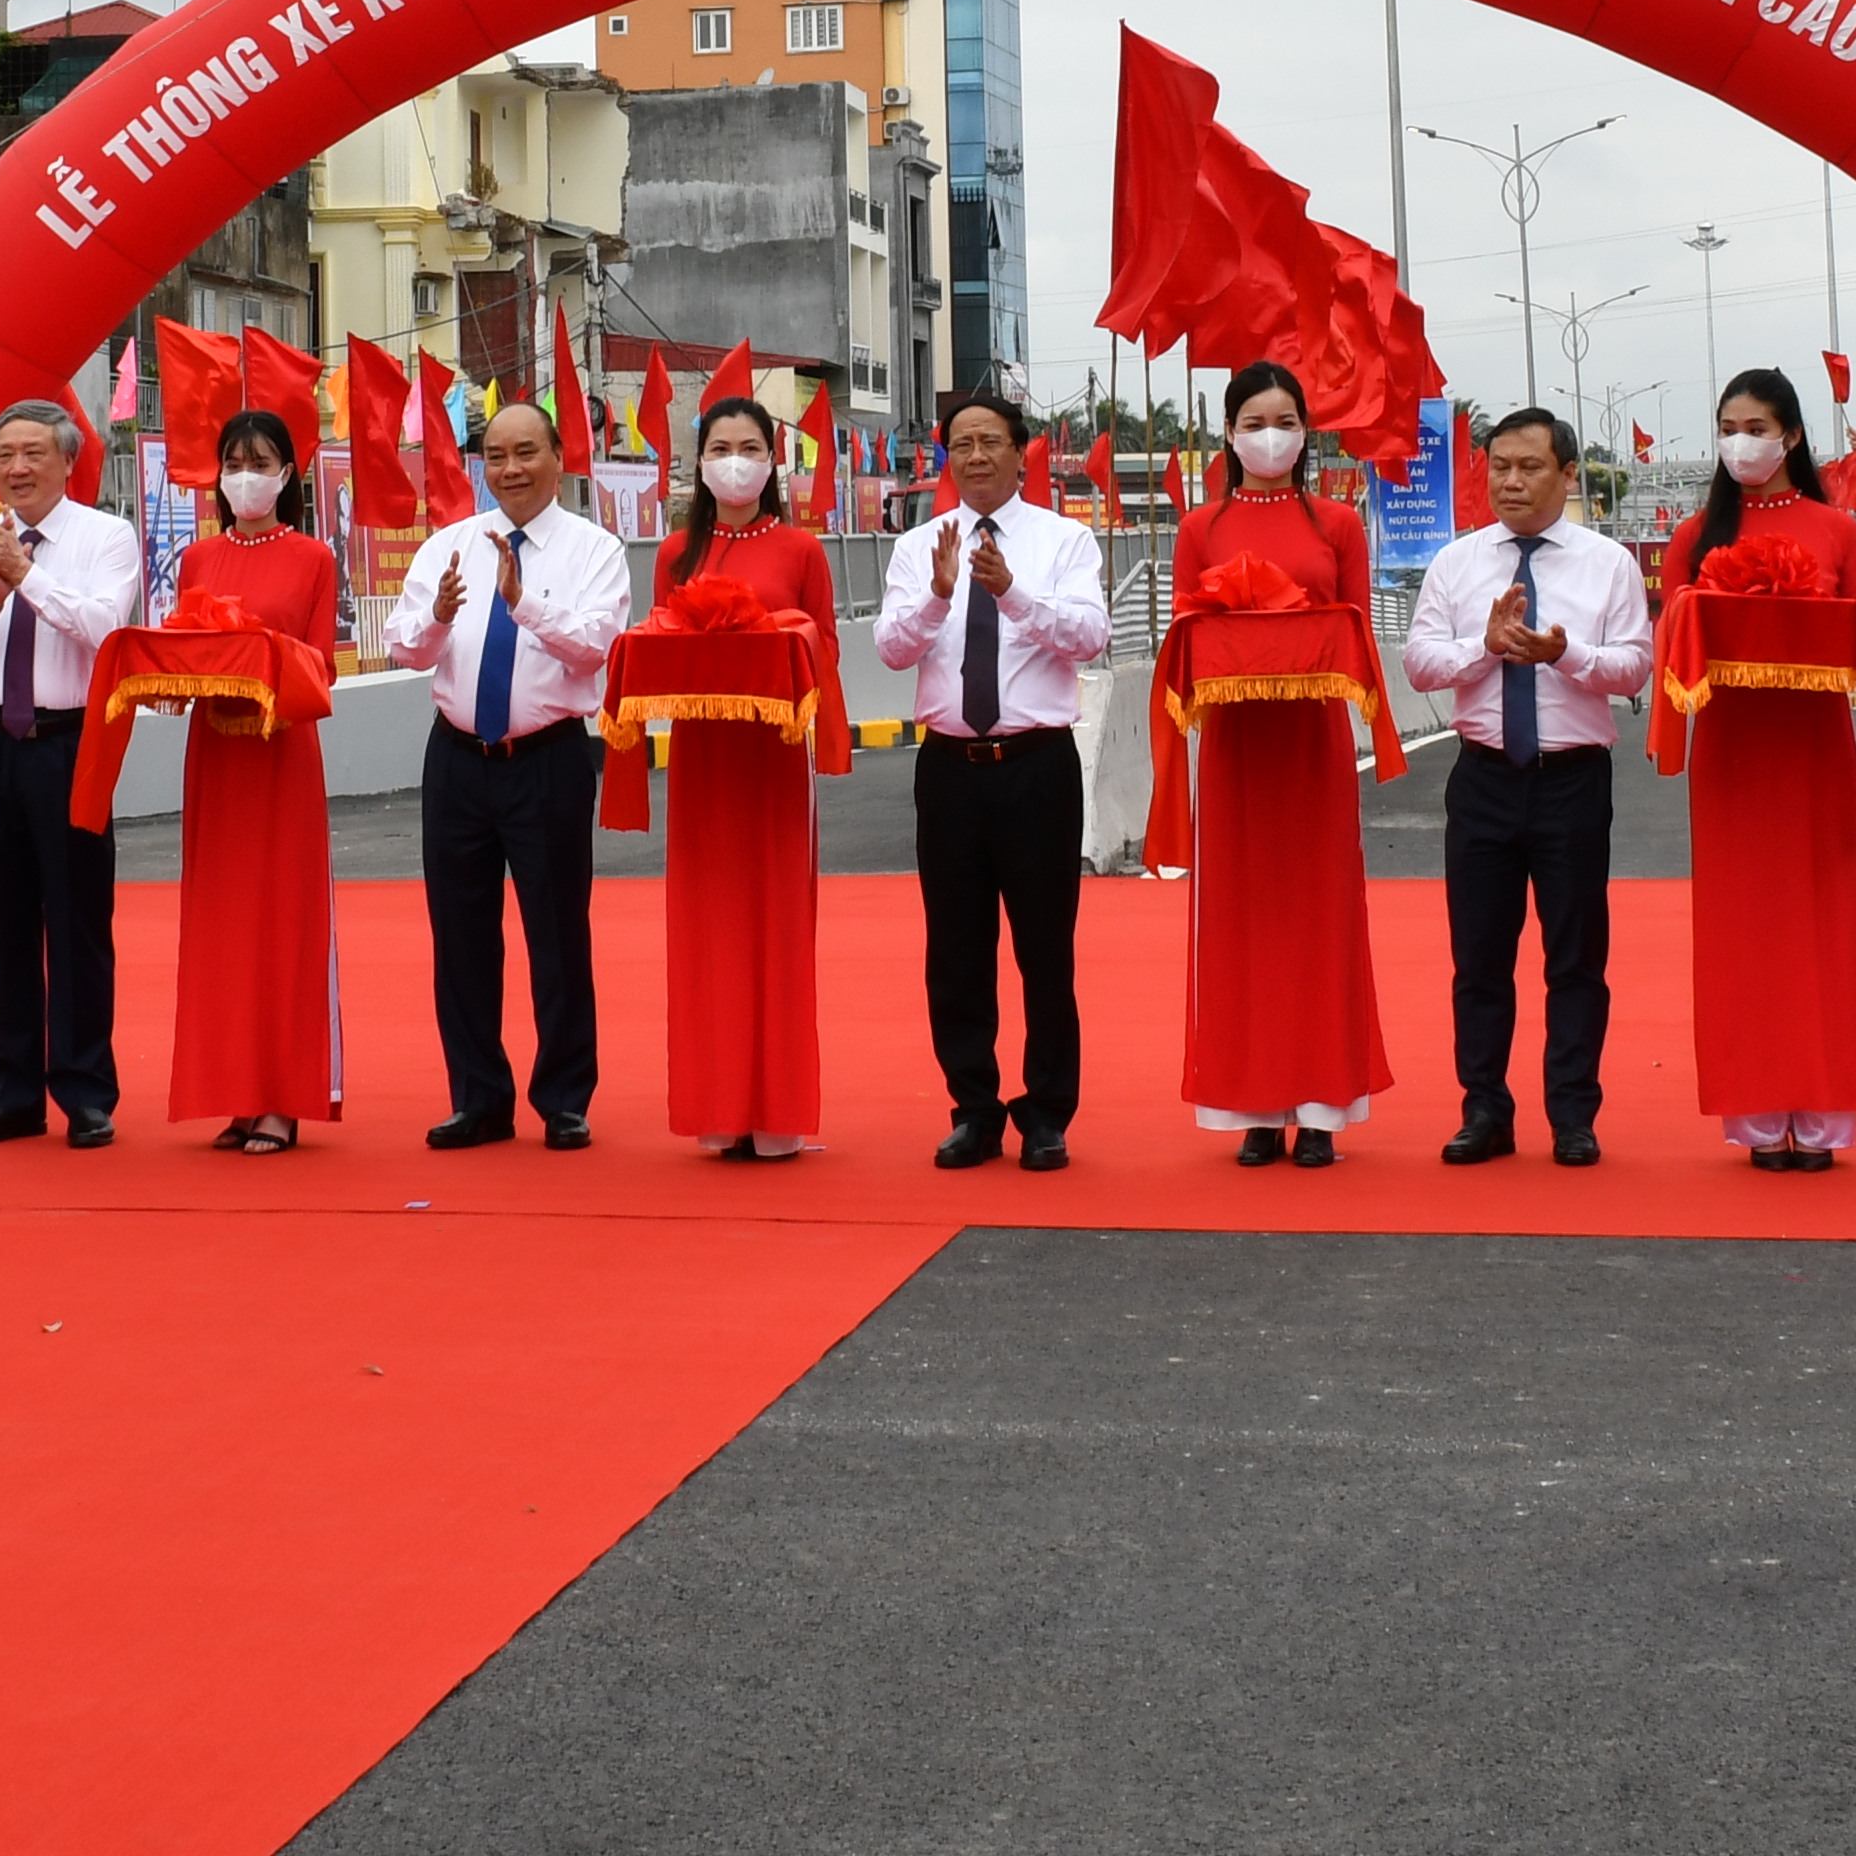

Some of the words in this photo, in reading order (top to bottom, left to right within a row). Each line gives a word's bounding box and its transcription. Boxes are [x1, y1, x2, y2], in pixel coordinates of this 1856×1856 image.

[35, 155, 116, 250] LỄ
[101, 36, 280, 184] THÔNG
[1427, 437, 1441, 446] XE
[1386, 498, 1405, 510] XÂY
[1406, 499, 1437, 511] DỰNG
[1388, 515, 1407, 525] NÚT
[1409, 515, 1435, 524] GIAO
